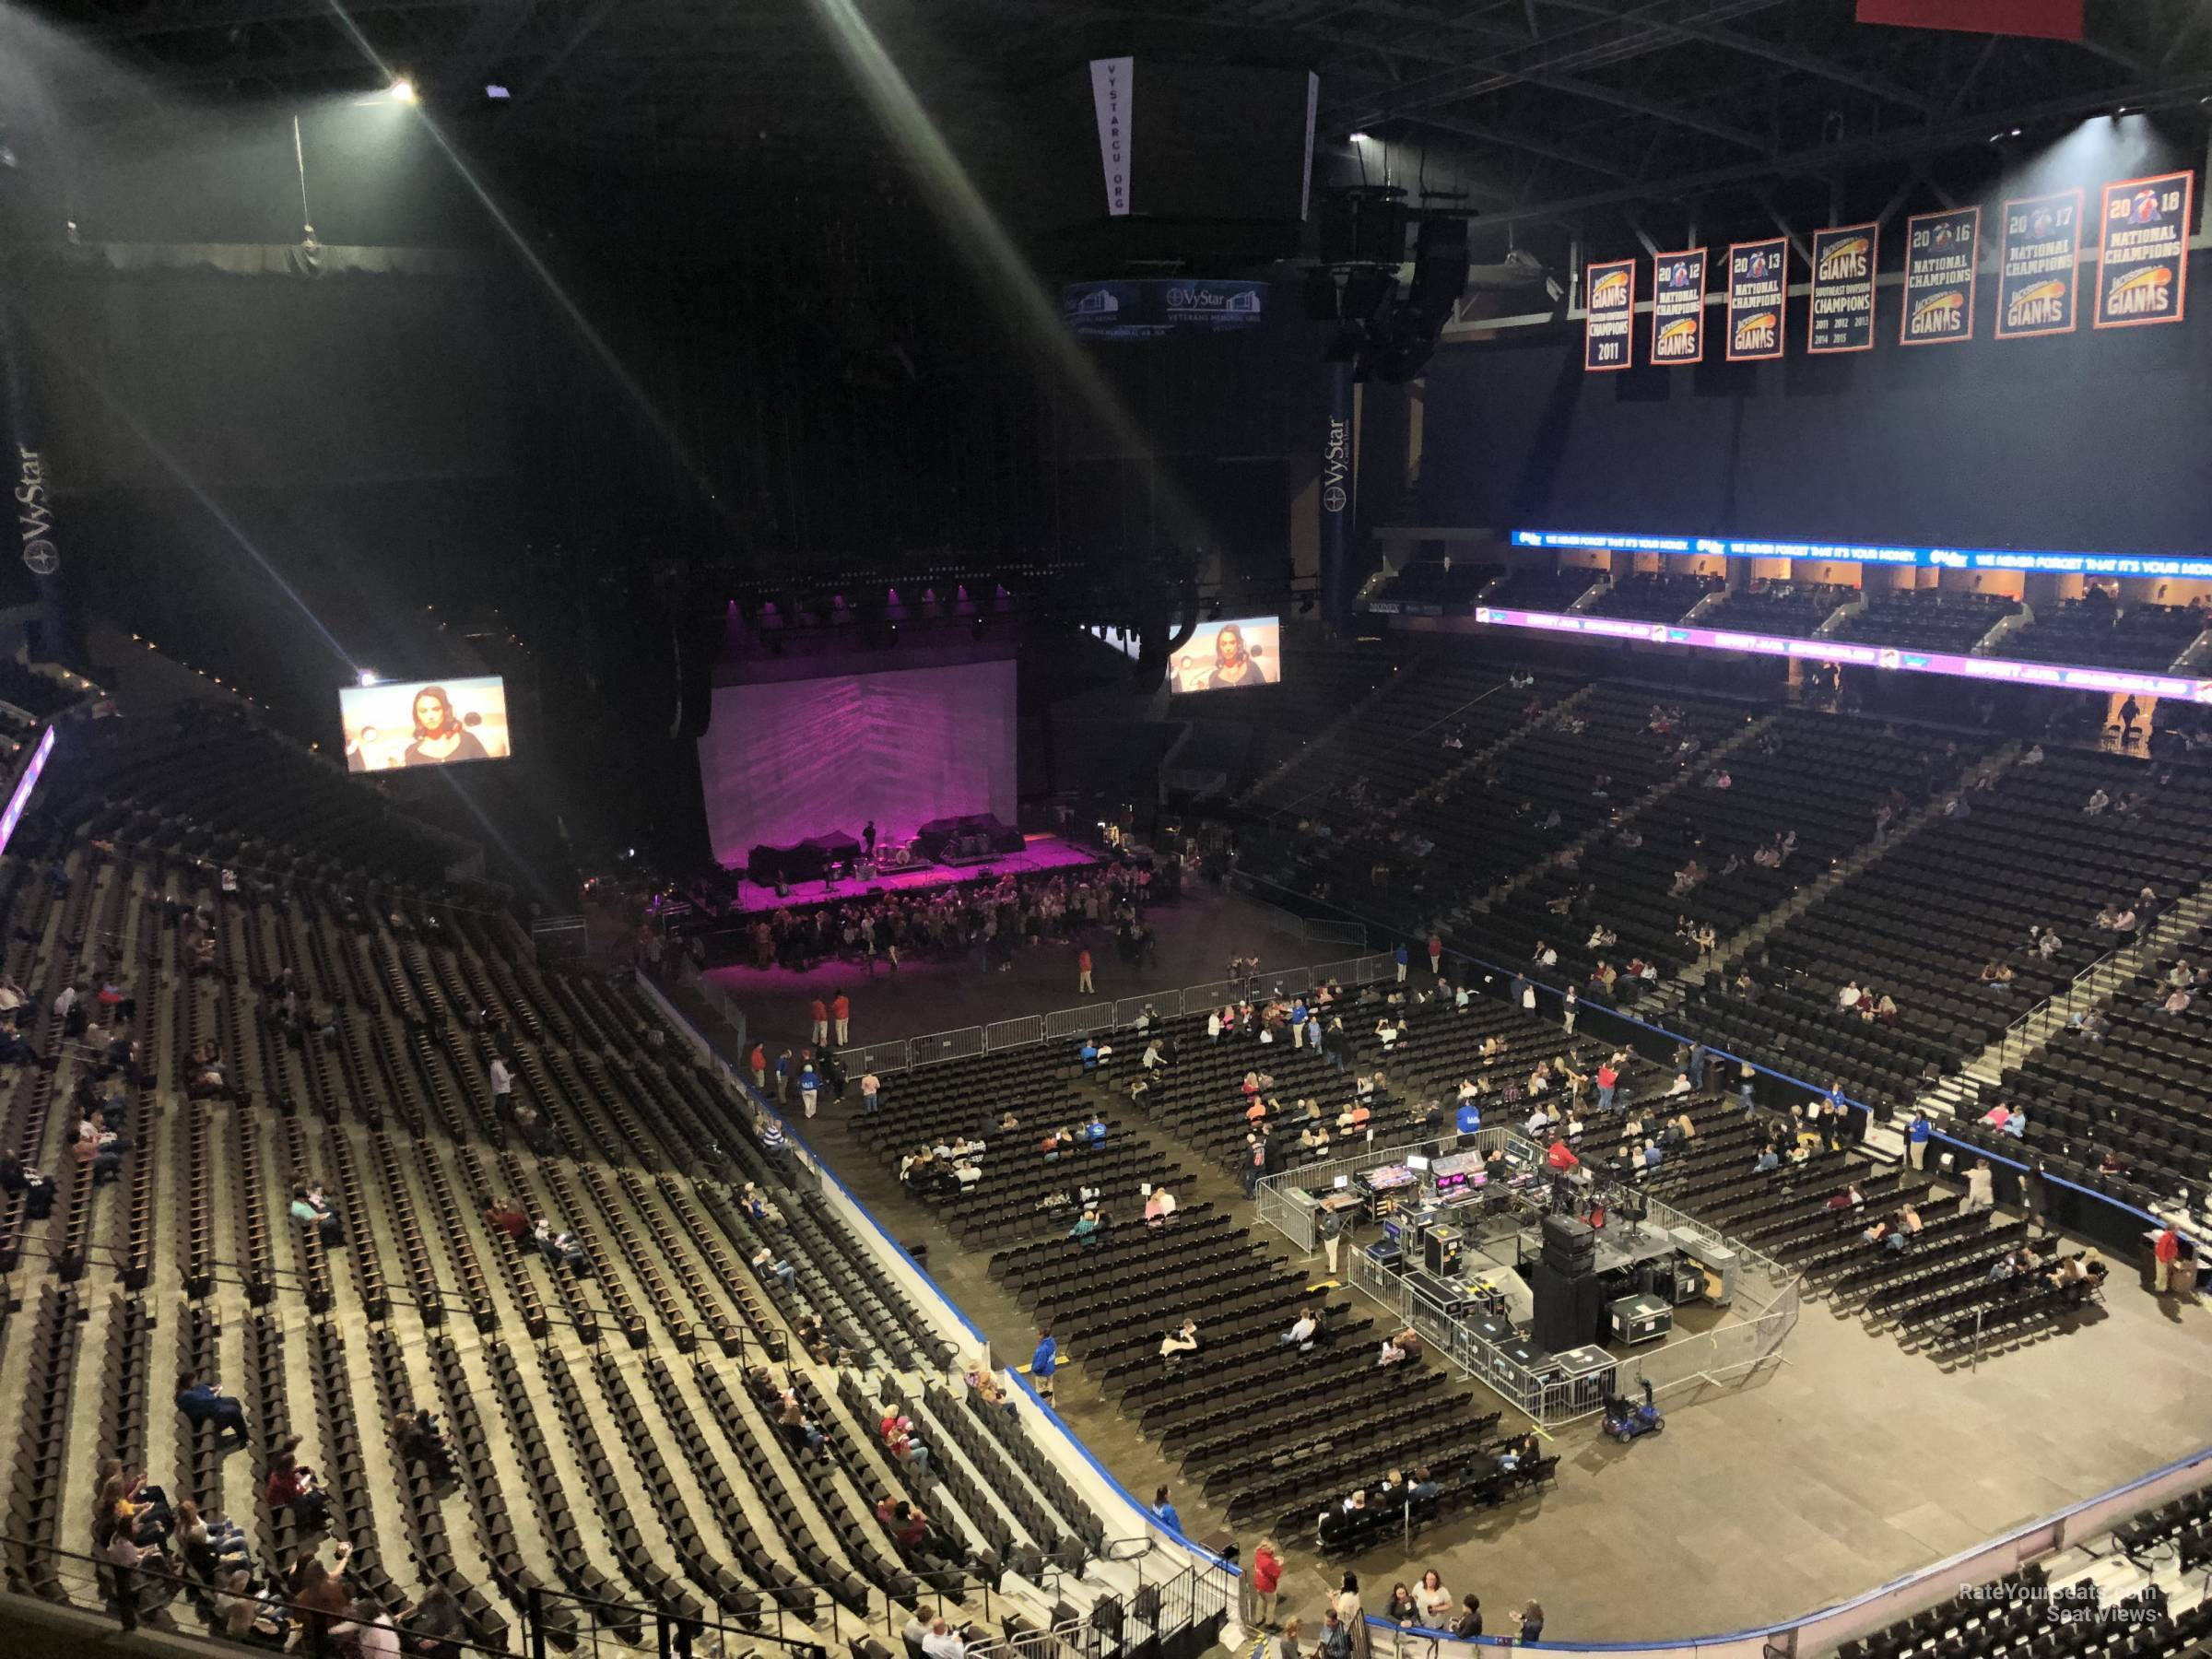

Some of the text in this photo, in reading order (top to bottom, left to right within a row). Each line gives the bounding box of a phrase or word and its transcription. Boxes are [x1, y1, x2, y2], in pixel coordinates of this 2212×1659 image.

[2110, 191, 2180, 219] 20 18
[2009, 206, 2073, 234] 20 17
[1912, 224, 1971, 248] 20 16
[2110, 225, 2177, 248] NATIONAL
[2009, 239, 2069, 261] NATIONAL
[2104, 241, 2183, 265] CHAMPIONS
[1659, 263, 1700, 282] 20 12
[1734, 253, 1781, 274] 20 13
[1818, 253, 1867, 281] GIANTS
[1913, 254, 1968, 274] NATIONAL
[2005, 253, 2073, 276] CHAMPIONS
[1735, 280, 1779, 296] NATIONAL
[1909, 268, 1971, 288] CHAMPIONS
[1182, 288, 1224, 309] VyStar
[1592, 286, 1628, 309] GIANTS
[1659, 288, 1699, 304] NATIONAL
[1732, 294, 1782, 309] CHAMPIONS
[1814, 295, 1870, 314] CHAMPIONS
[2107, 284, 2169, 316] GIANTS
[1656, 301, 1700, 315] CHAMPIONS
[2007, 297, 2063, 327] GIANTS
[1590, 321, 1629, 336] CHAMPIONS
[1911, 307, 1961, 335] GIANTS
[1657, 333, 1696, 356] GIANTS
[1735, 326, 1775, 350] GIANTS
[1598, 342, 1619, 361] 2011
[1324, 418, 1348, 486] VyStar
[15, 445, 54, 540] VyStar
[1976, 555, 1994, 566] WE
[2036, 557, 2083, 570] FORGET
[2086, 559, 2116, 571] THAT
[2142, 561, 2180, 573] YOUR
